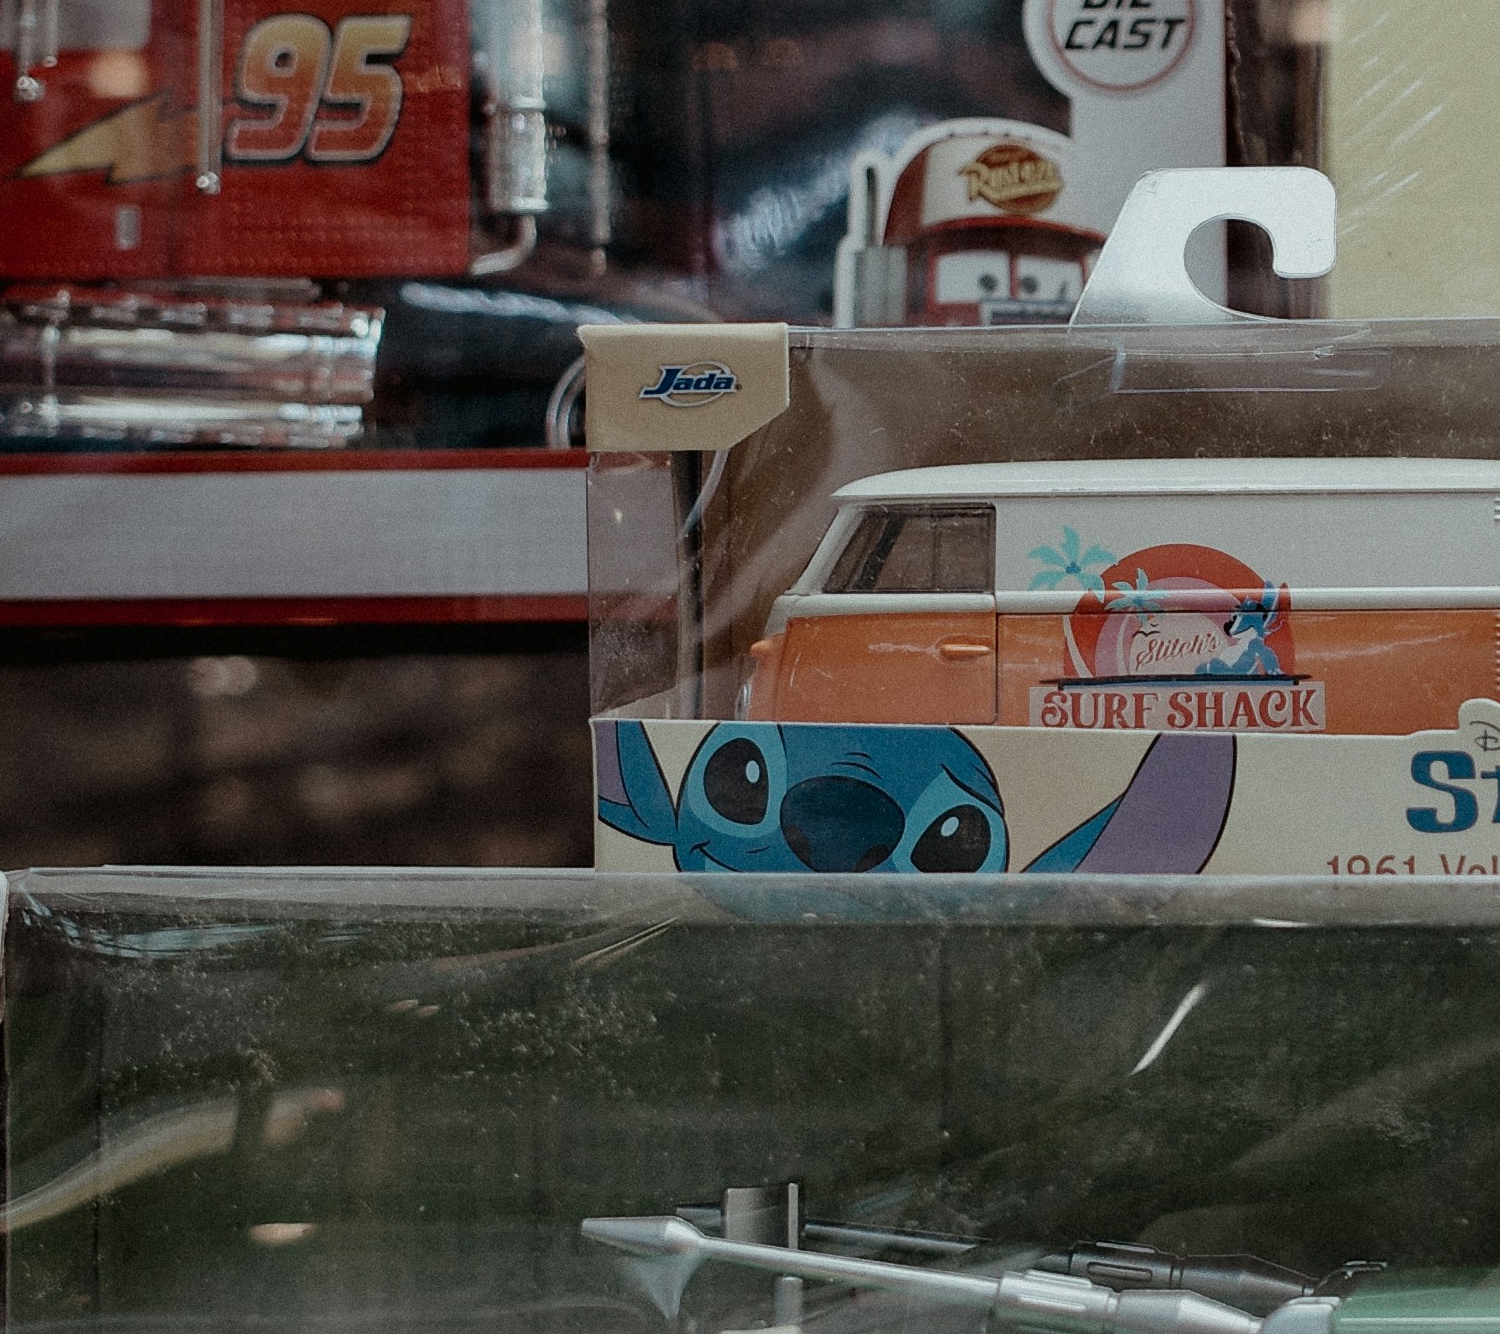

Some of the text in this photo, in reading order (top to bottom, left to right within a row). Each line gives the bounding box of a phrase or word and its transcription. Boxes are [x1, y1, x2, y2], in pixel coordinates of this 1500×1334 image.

[1066, 17, 1186, 51] CAST
[224, 11, 414, 166] 95
[642, 366, 736, 396] Jada
[1136, 632, 1221, 671] Stitch's
[1041, 688, 1319, 729] SURF SHACK
